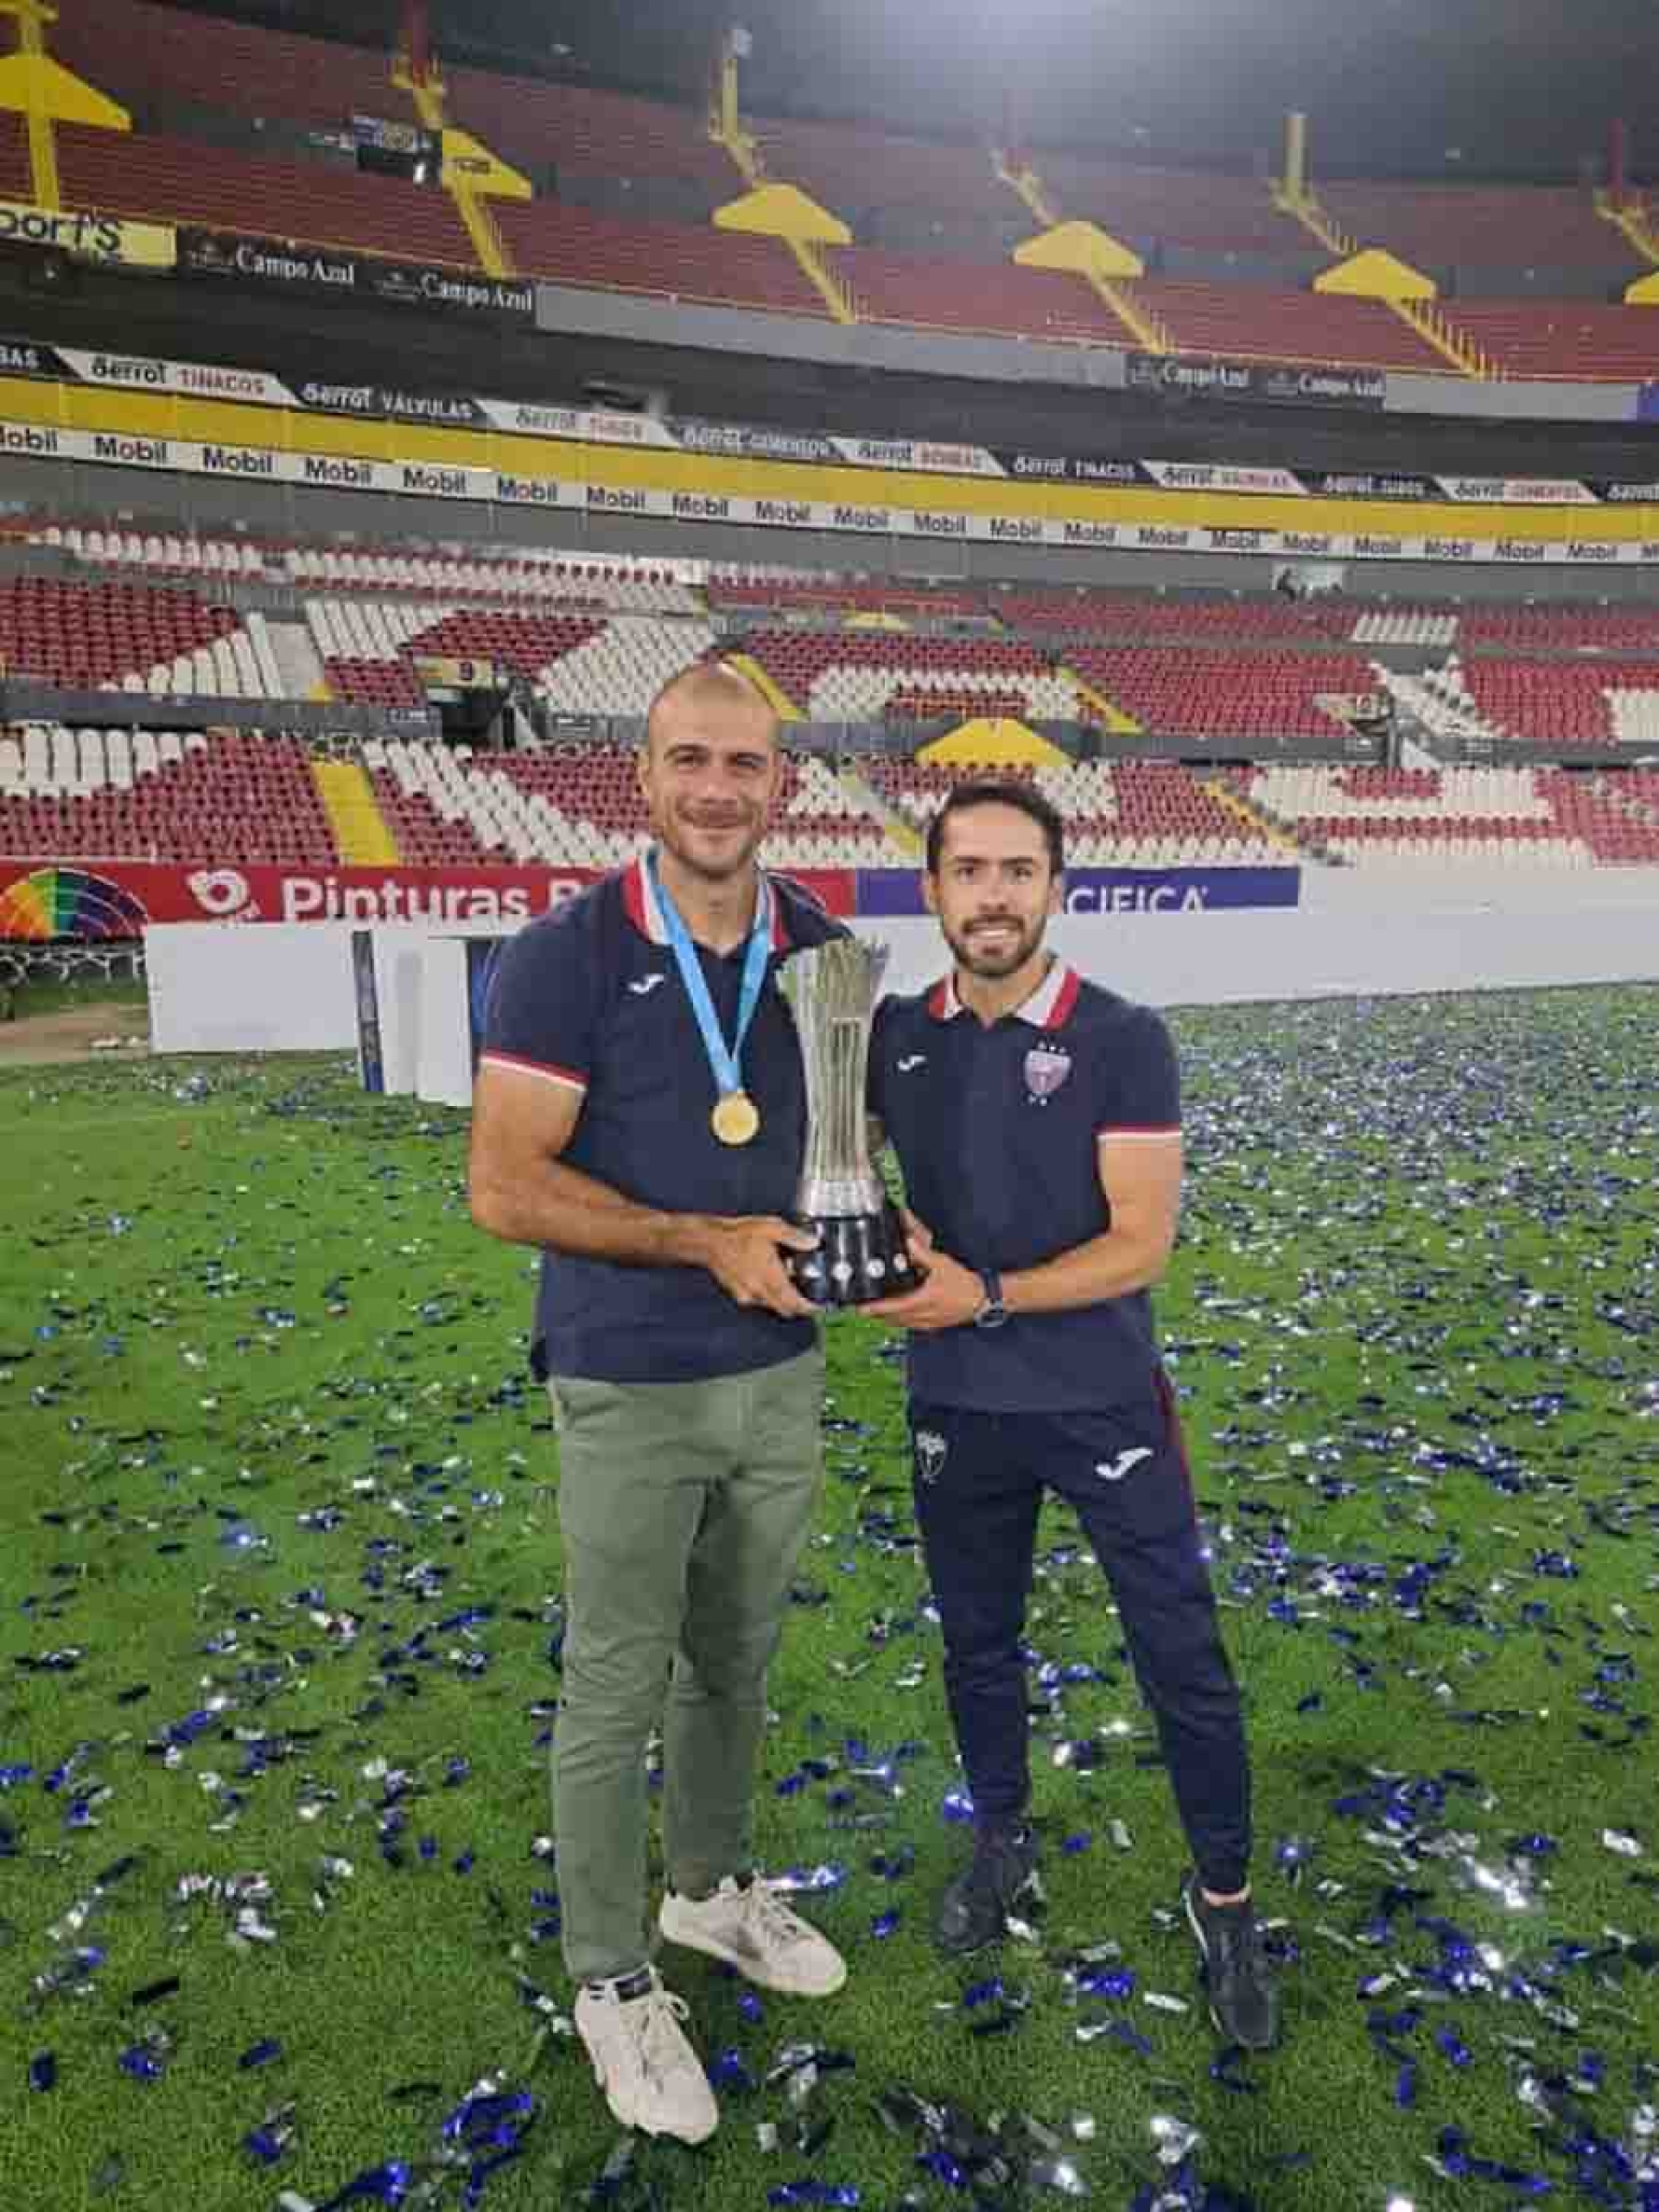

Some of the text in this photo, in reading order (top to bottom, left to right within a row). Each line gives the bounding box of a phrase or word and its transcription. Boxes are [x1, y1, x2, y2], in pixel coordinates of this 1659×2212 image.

[236, 245, 308, 278] Campo
[311, 257, 354, 283] Azul
[420, 271, 490, 306] Campo
[493, 284, 532, 311] Azul
[177, 365, 266, 397] TINACOS
[0, 425, 59, 454] obil
[94, 435, 168, 466] Mobil
[202, 446, 273, 475] Mobil
[304, 456, 372, 486] Mobil
[403, 467, 467, 495] Mobil
[496, 474, 558, 502] Mobil
[588, 485, 646, 510] Mobil
[672, 493, 729, 518] Mobil
[755, 500, 811, 524] Mobil
[834, 504, 889, 529] Mobil
[913, 513, 967, 533] Mobil
[989, 517, 1042, 539] Mobil
[1064, 520, 1117, 544] Mobil
[1138, 526, 1189, 546] Mobil
[1211, 530, 1262, 549] Mobil
[1284, 532, 1328, 552] Mobil
[1357, 536, 1403, 556] Mobil
[1426, 538, 1473, 558] Mobil
[1494, 537, 1545, 561] Mobil
[1567, 540, 1618, 561] Mobil
[281, 874, 531, 924] Pinturas
[1066, 885, 1204, 915] CIFICA
